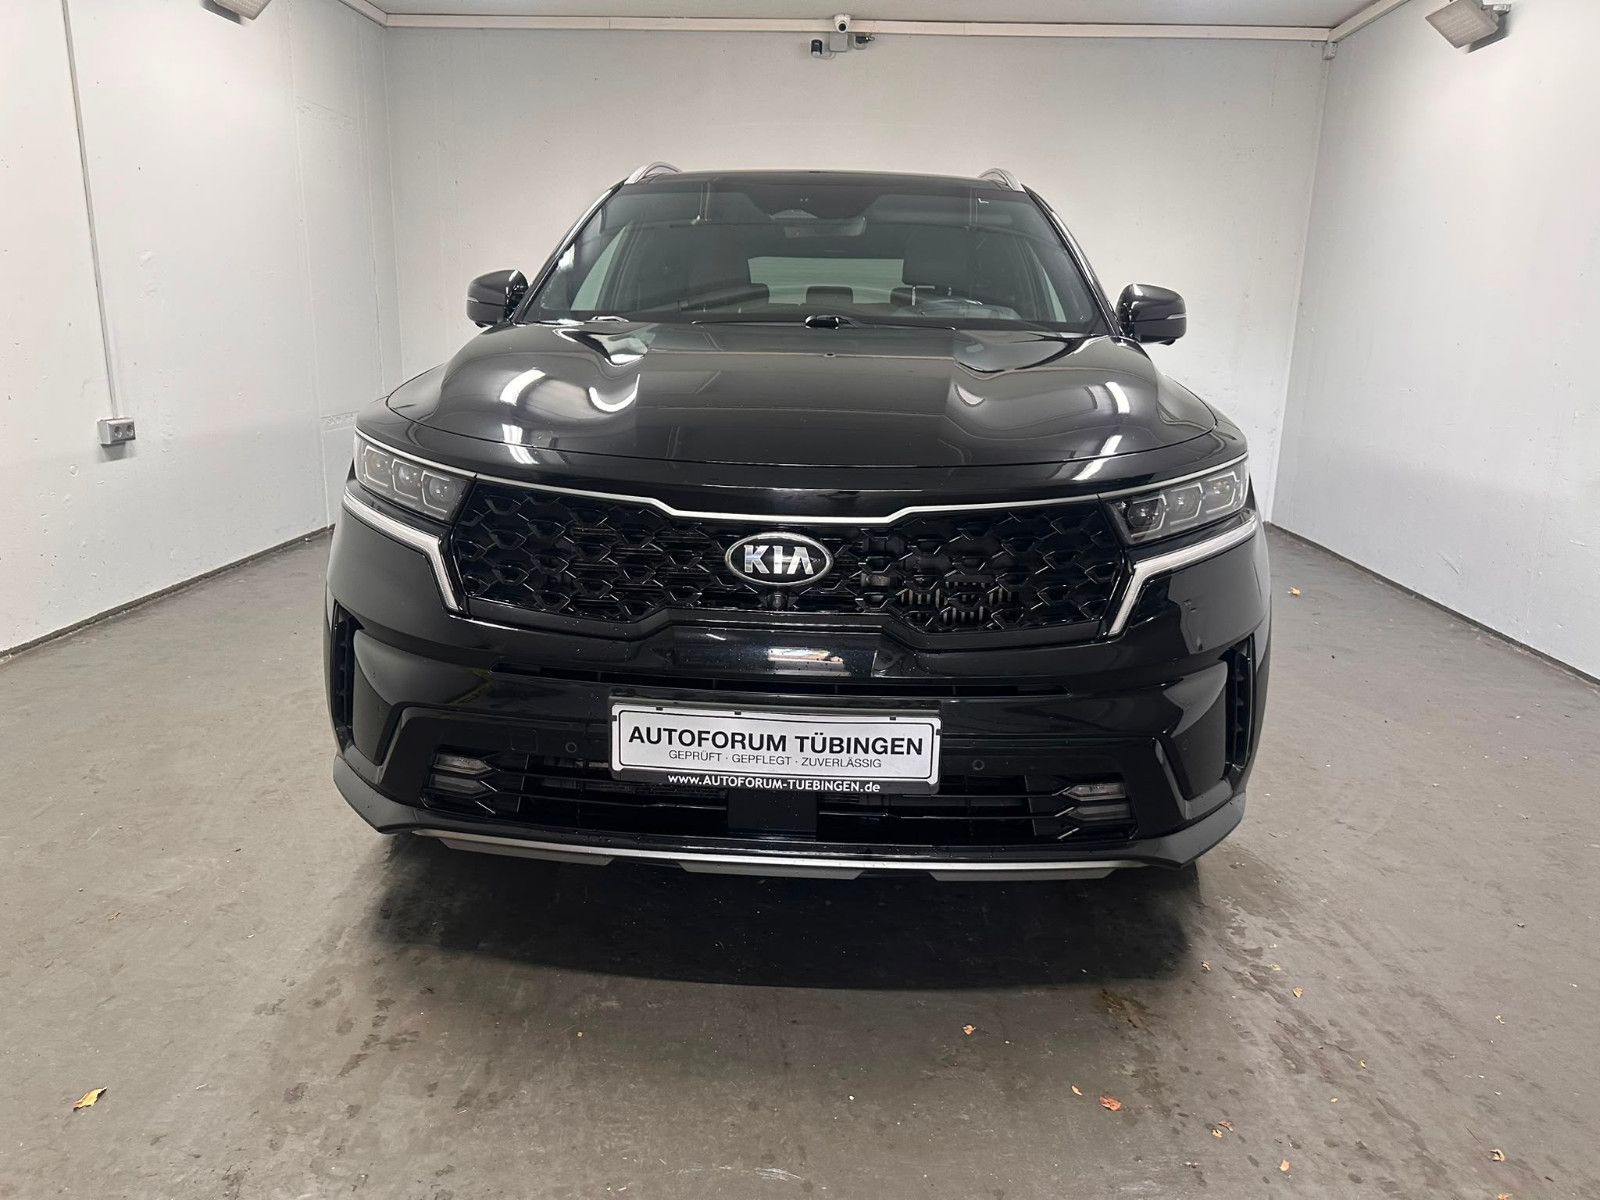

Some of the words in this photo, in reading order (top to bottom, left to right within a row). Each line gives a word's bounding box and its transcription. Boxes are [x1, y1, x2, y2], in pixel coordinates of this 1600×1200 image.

[744, 544, 814, 575] KIA
[628, 725, 787, 752] AUTOFORUM
[795, 732, 923, 755] TÜBINGEN
[668, 748, 722, 762] GEPRÜFT
[731, 753, 792, 766] GEPFLEGT
[801, 755, 882, 768] ZUVERLÄSSIG
[667, 773, 881, 793] www.AUTOFORUM-TUEBINGEN.de
